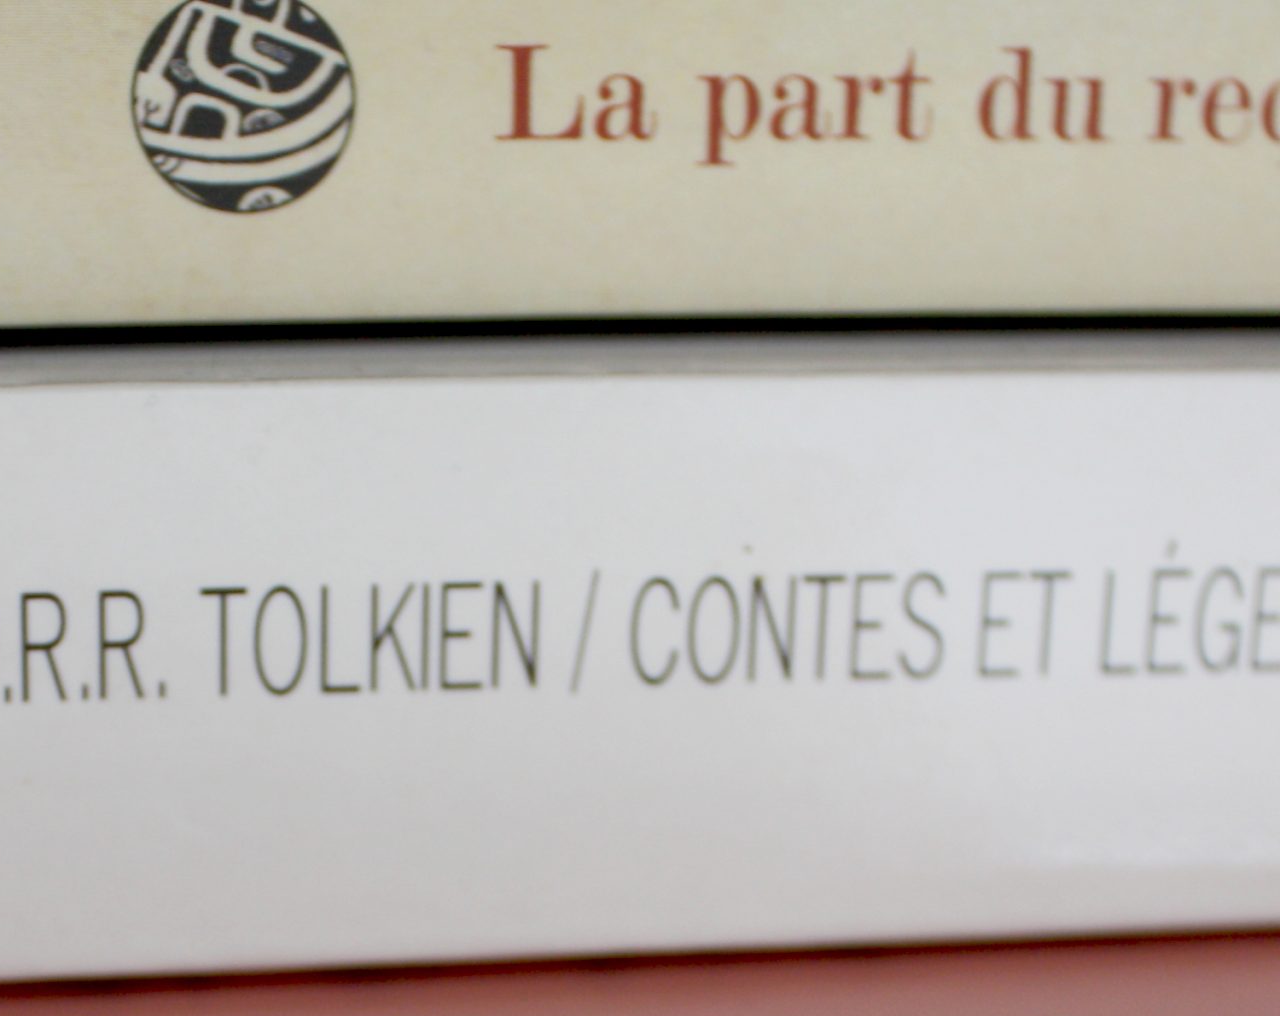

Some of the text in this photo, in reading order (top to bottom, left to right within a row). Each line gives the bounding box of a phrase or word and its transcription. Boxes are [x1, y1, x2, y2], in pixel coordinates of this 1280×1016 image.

[495, 44, 654, 142] La
[696, 53, 932, 167] part
[976, 46, 1110, 143] du
[197, 578, 541, 698] TOLKIEN
[628, 567, 946, 687] CONTES
[975, 567, 1074, 679] ET
